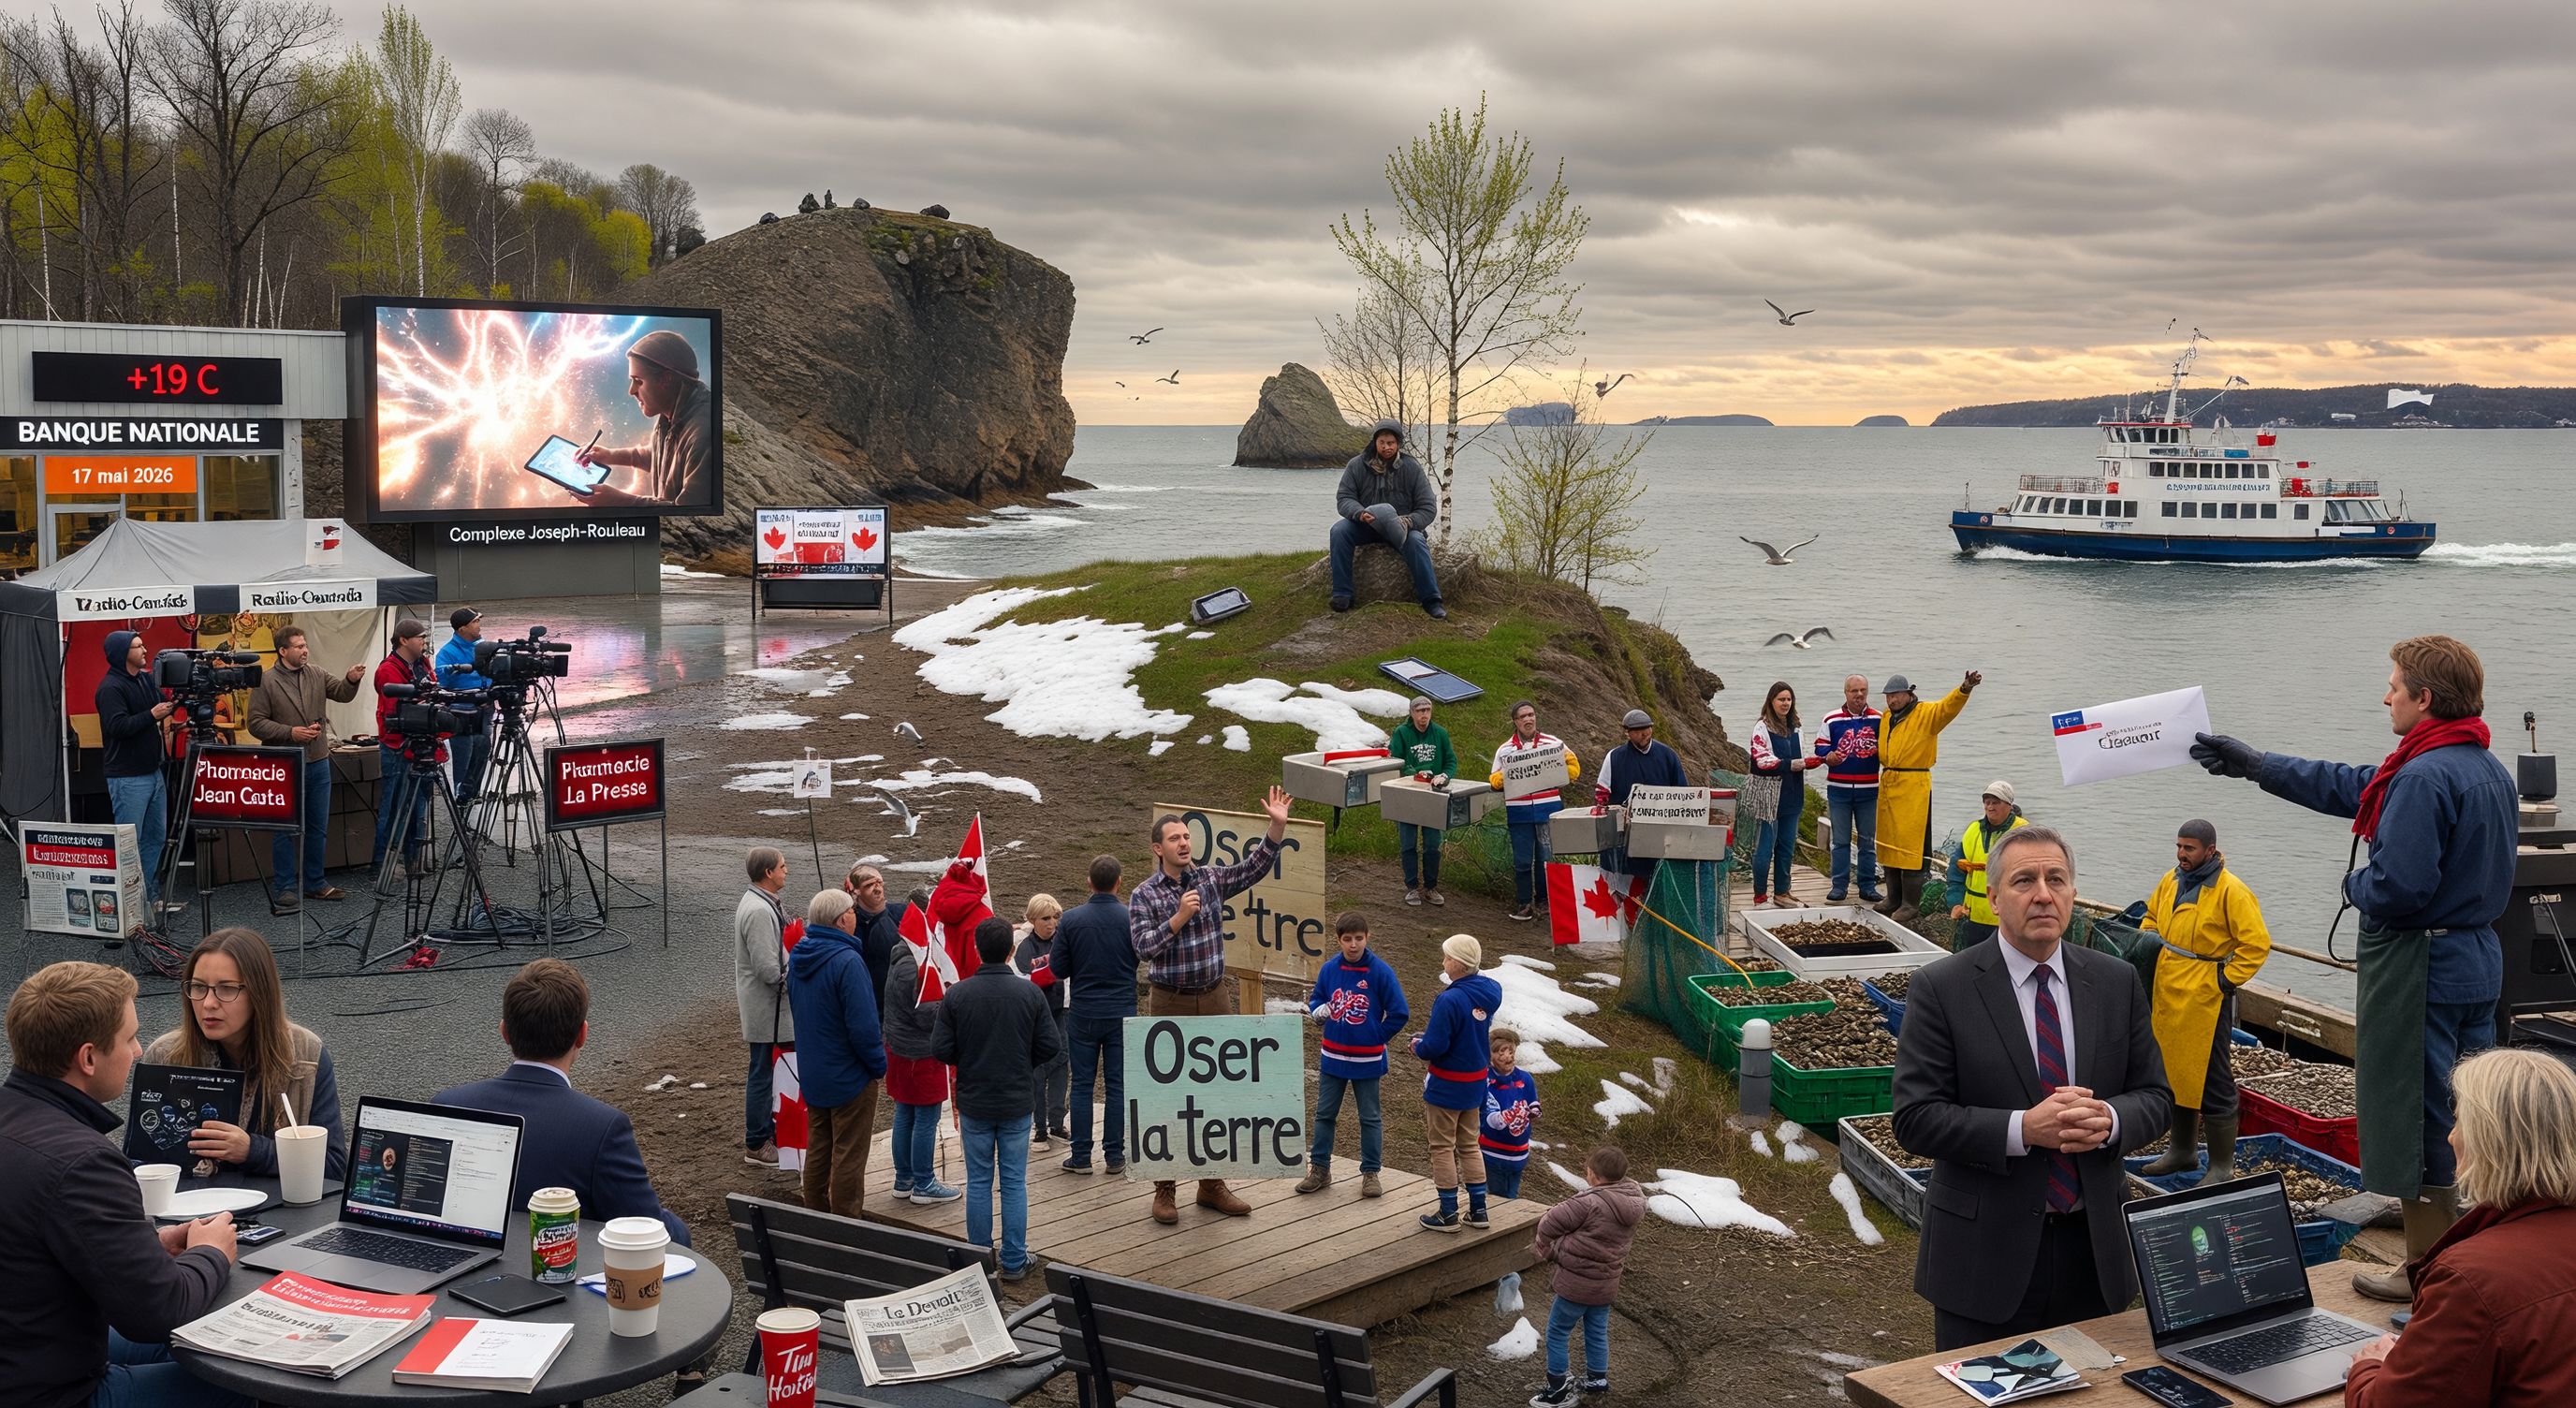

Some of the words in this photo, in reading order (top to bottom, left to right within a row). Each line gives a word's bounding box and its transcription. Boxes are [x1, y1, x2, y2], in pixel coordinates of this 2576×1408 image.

[126, 363, 188, 395] +19
[197, 364, 219, 395] C
[18, 421, 123, 445] BANQUE
[129, 422, 259, 443] NATIONALE
[72, 468, 92, 484] 17
[97, 467, 127, 484] mai
[133, 467, 173, 483] 2026
[449, 525, 526, 544] Complexe
[528, 521, 646, 543] Joseph-Rouleau
[194, 784, 236, 804] Jean
[591, 781, 648, 802] Presse
[1144, 1019, 1280, 1084] Oser
[1130, 1098, 1174, 1164] la
[1177, 1094, 1303, 1167] terre
